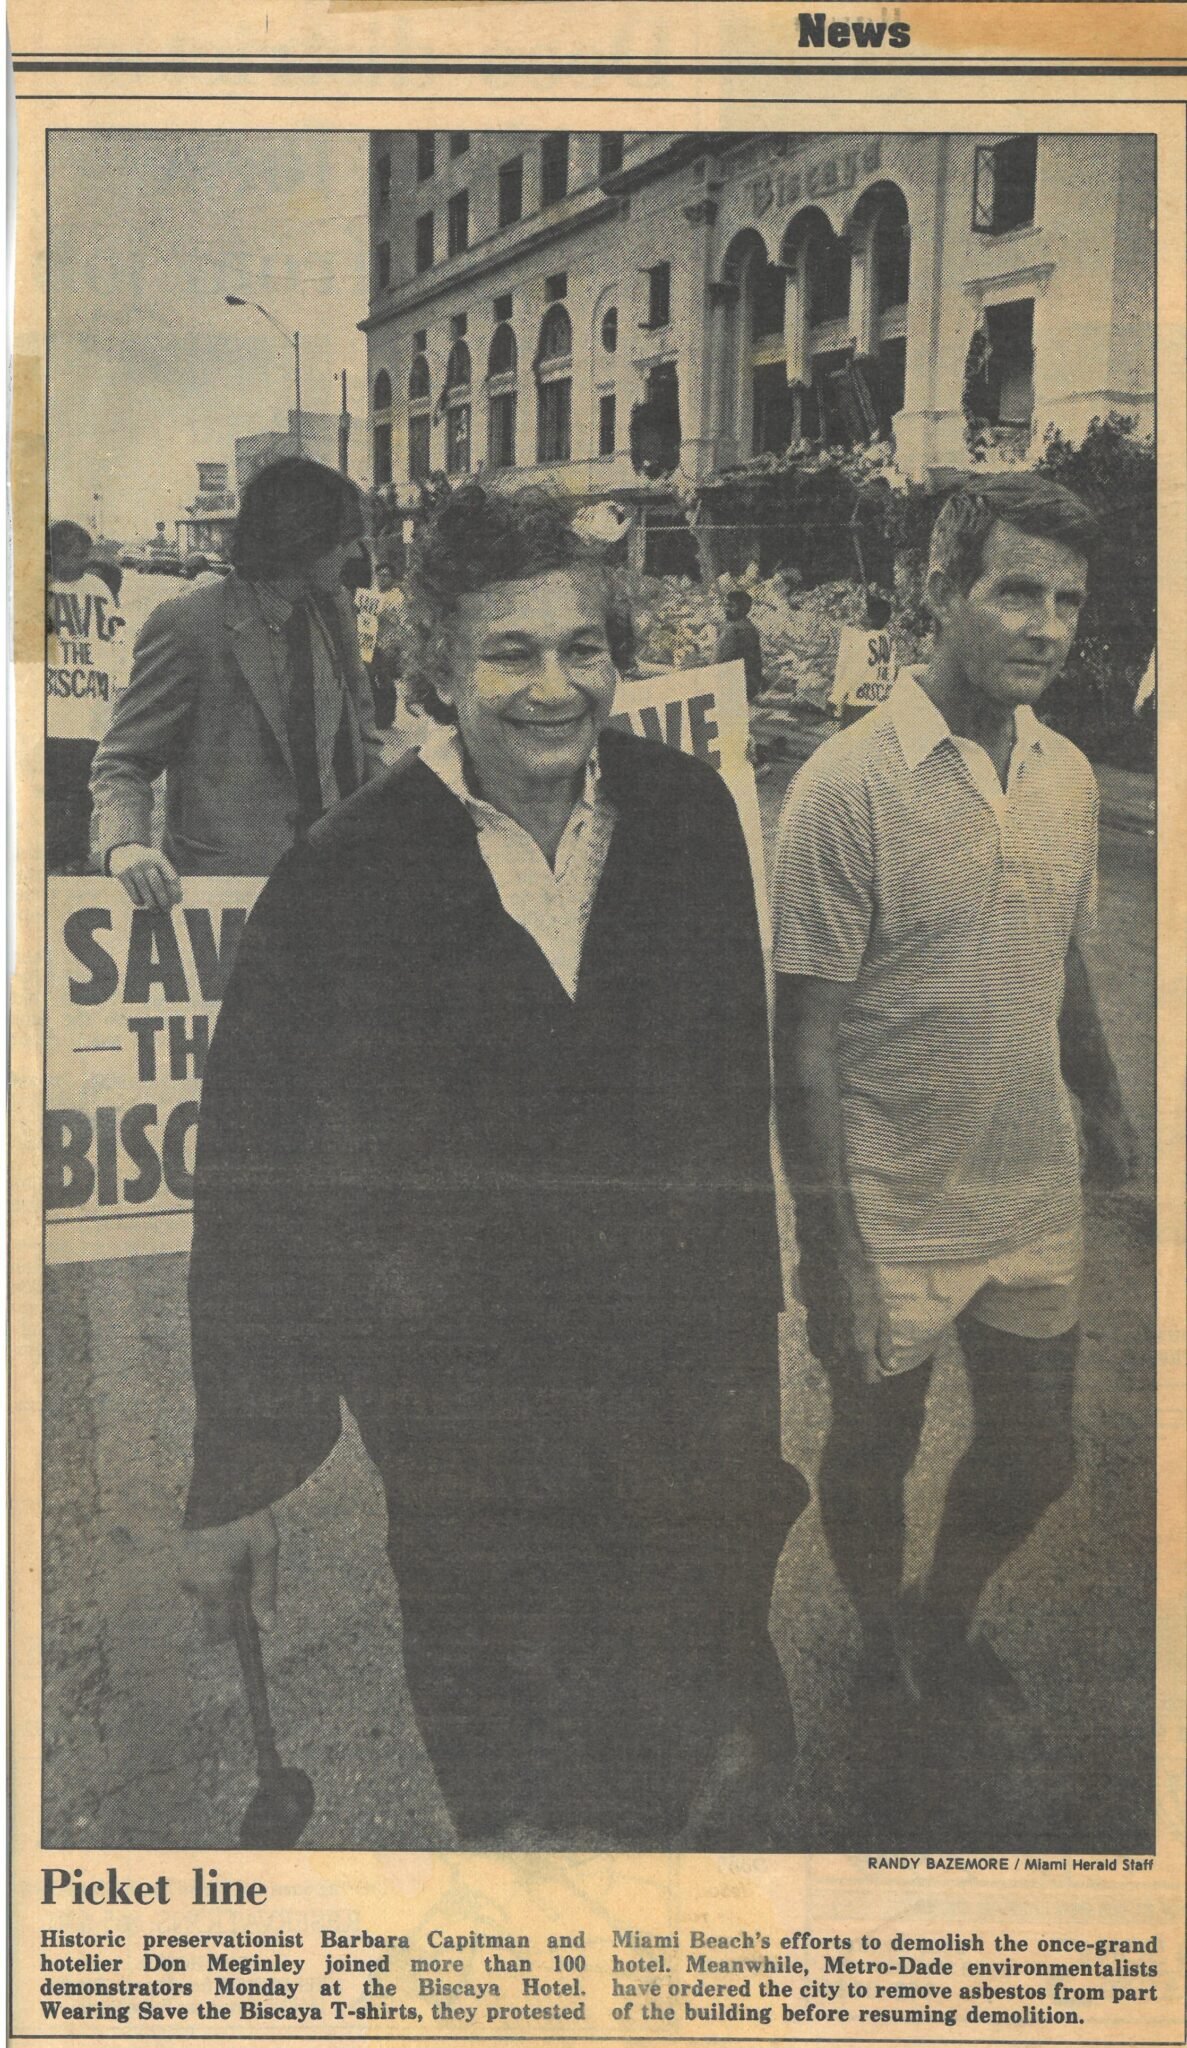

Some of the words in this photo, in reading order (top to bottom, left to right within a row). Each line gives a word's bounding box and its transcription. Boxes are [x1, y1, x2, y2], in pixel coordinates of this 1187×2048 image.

[797, 12, 911, 49] News
[60, 641, 94, 665] THE
[868, 1857, 921, 1870] RANDY
[926, 1857, 1009, 1871] BAZEMORE
[1024, 1858, 1067, 1871] Miami
[1072, 1858, 1117, 1871] Herald
[1122, 1858, 1154, 1872] Staff
[40, 1867, 171, 1906] Picket
[191, 1867, 267, 1906] line
[40, 1929, 126, 1948] Historic
[142, 1929, 304, 1951] preservationist
[320, 1929, 410, 1949] Barbara
[427, 1930, 530, 1952] Capitman
[547, 1931, 585, 1949] and
[612, 1929, 679, 1950] Miami
[690, 1931, 771, 1949] Beach's
[780, 1931, 852, 1950] efforts
[861, 1934, 882, 1951] to
[890, 1932, 985, 1952] demolish
[994, 1932, 1029, 1953] the
[1037, 1934, 1158, 1958] once-grand
[40, 1953, 123, 1973] hotelier
[143, 1953, 187, 1972] Don
[207, 1953, 306, 1976] Meginley
[324, 1954, 390, 1976] joined
[410, 1959, 463, 1972] more
[484, 1953, 531, 1973] than
[553, 1954, 586, 1973] 100
[612, 1954, 671, 1974] hotel.
[686, 1954, 809, 1977] Meanwhile,
[823, 1955, 953, 1976] Metro-Dade
[967, 1956, 1158, 1978] environmentalists
[39, 1977, 193, 1997] demonstrators
[214, 1977, 300, 2000] Monday
[320, 1980, 342, 1997] at
[362, 1977, 397, 1997] the
[418, 1977, 501, 1999] Biscaya
[522, 1978, 586, 1997] Hotel.
[612, 1978, 661, 1997] have
[668, 1979, 751, 1998] ordered
[758, 1979, 793, 1999] the
[799, 1979, 840, 2001] city
[847, 1982, 868, 1999] to
[875, 1985, 953, 2000] remove
[959, 1981, 1047, 2001] asbestos
[1053, 1981, 1105, 2001] from
[1112, 1985, 1158, 2004] part
[39, 2000, 131, 2024] Wearing
[138, 2001, 189, 2021] Save
[196, 2001, 231, 2020] the
[239, 2001, 323, 2023] Biscaya
[330, 2001, 423, 2023] T-shirts,
[431, 2001, 478, 2023] they
[486, 2001, 586, 2023] protested
[612, 2002, 634, 2020] of
[642, 2002, 675, 2021] the
[684, 2002, 772, 2024] building
[781, 2002, 850, 2023] before
[858, 2003, 958, 2026] resuming
[966, 2004, 1085, 2025] demolition.
